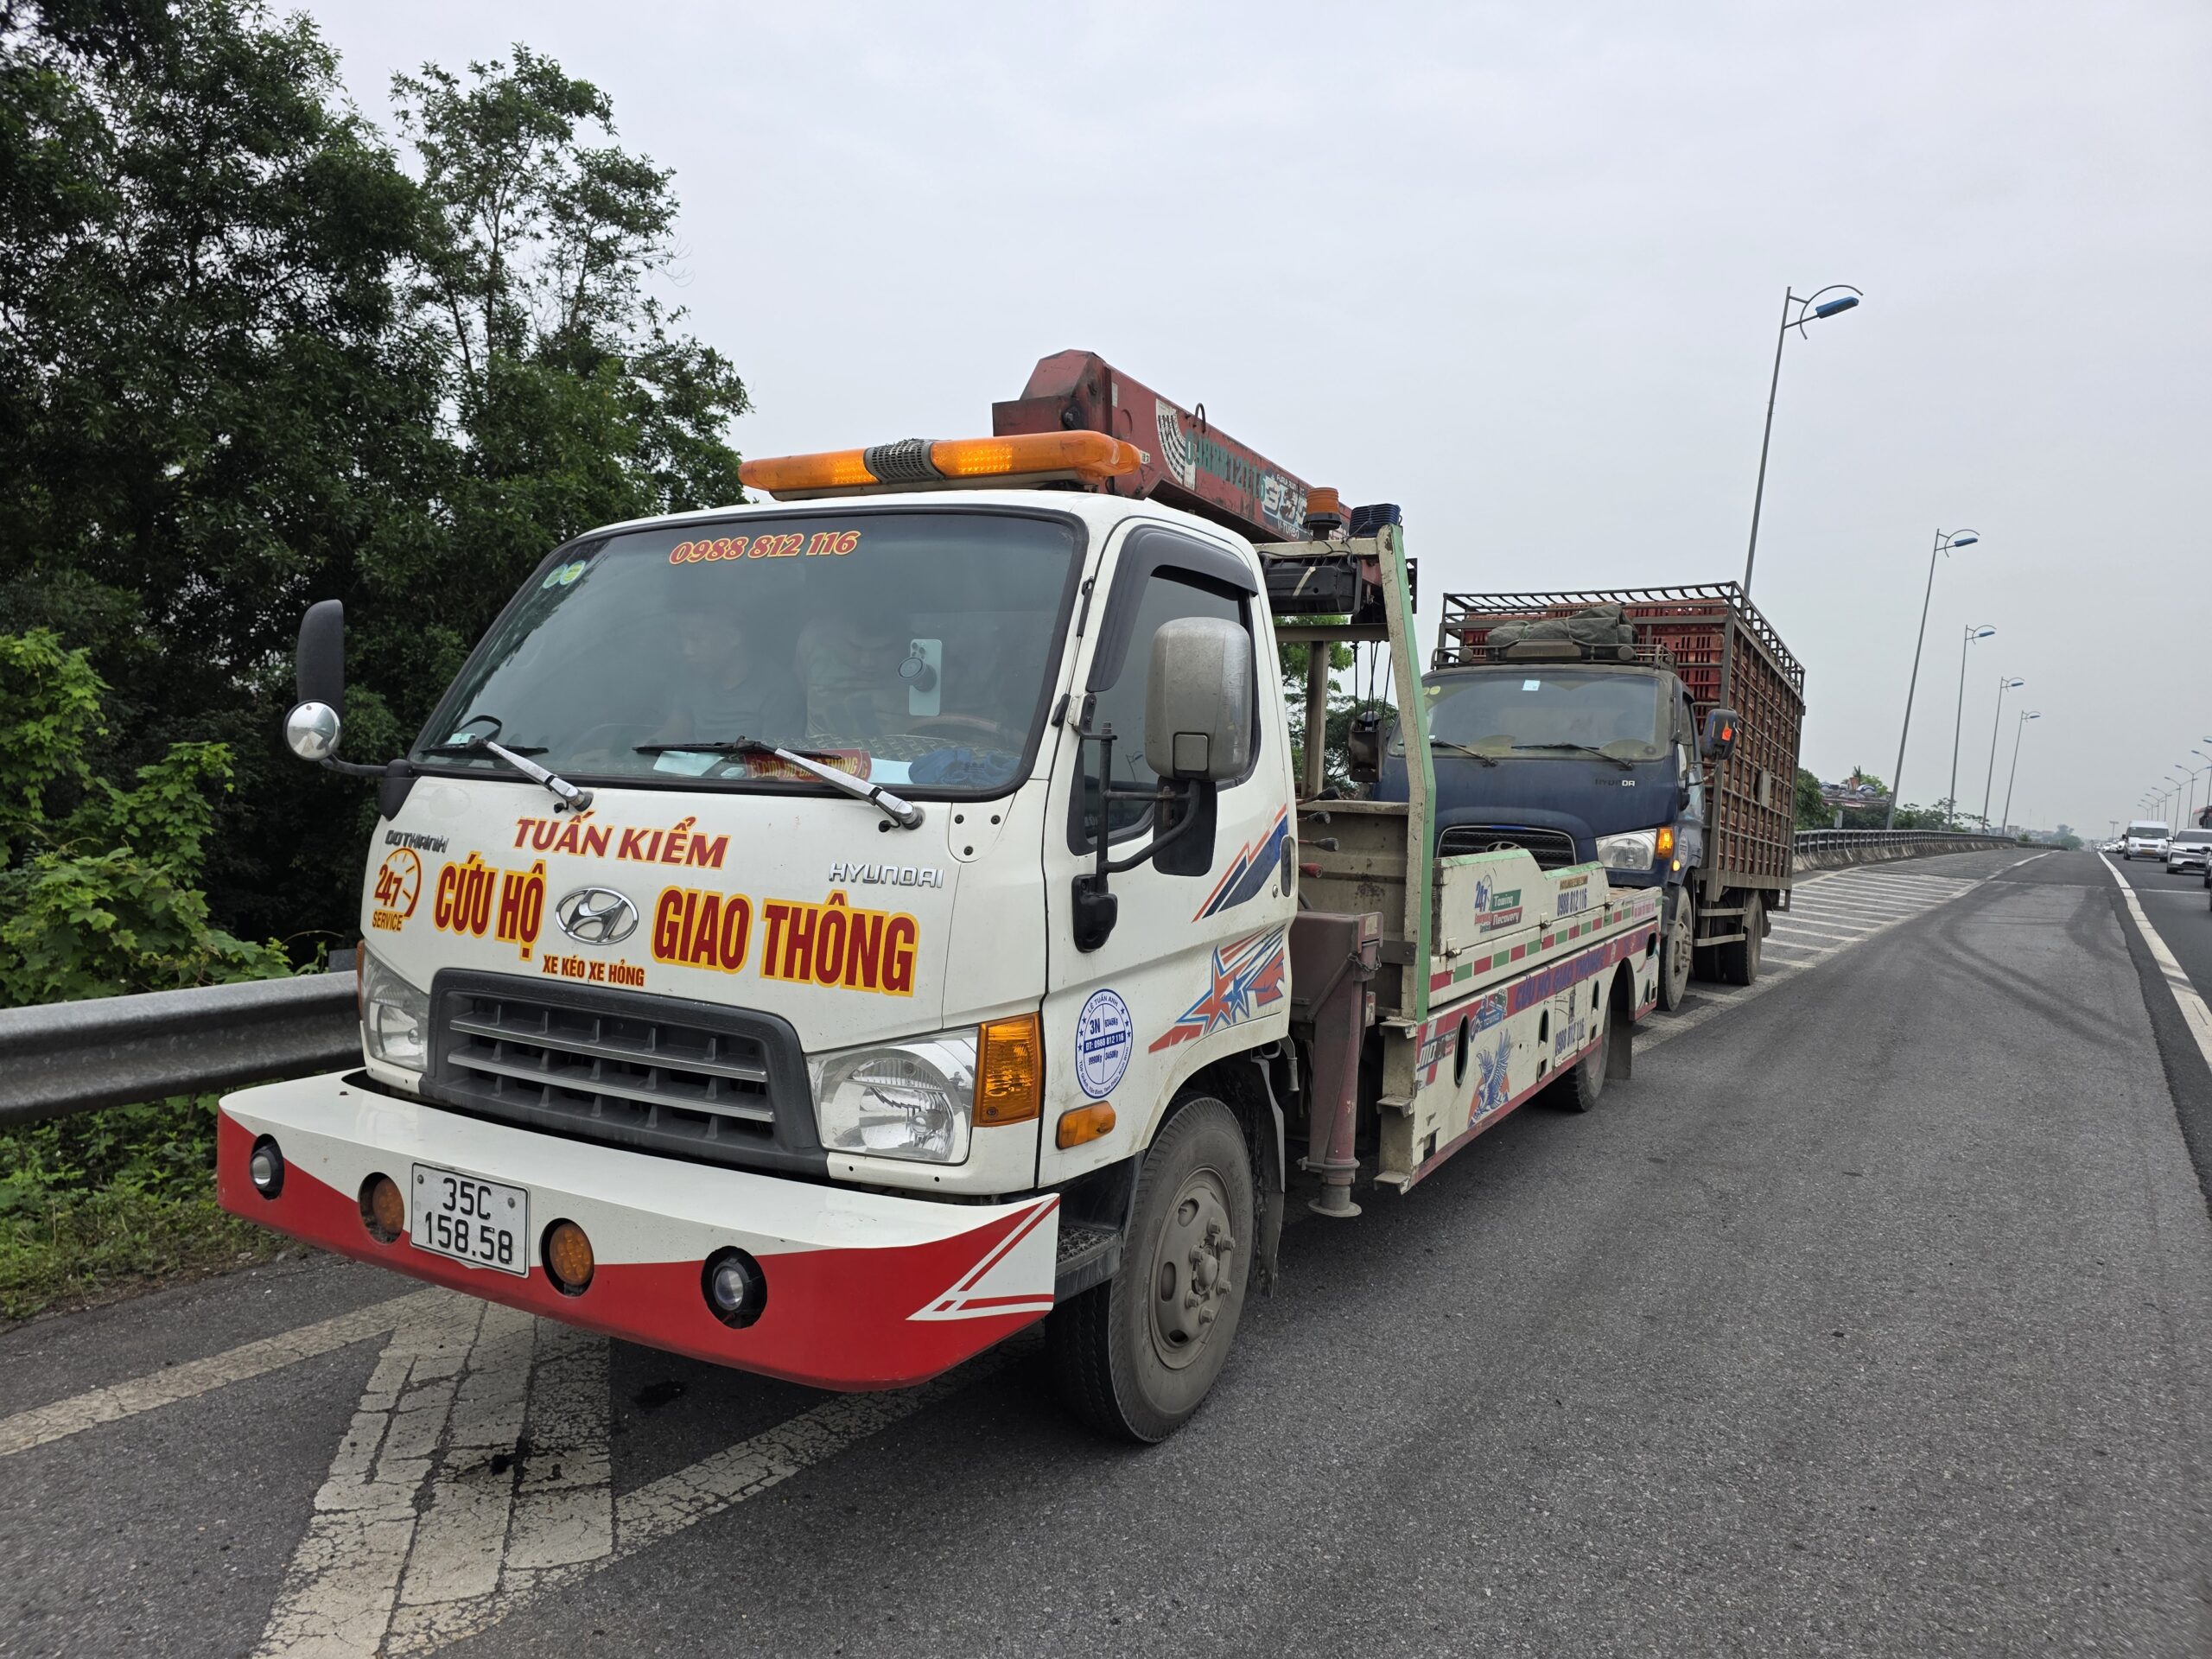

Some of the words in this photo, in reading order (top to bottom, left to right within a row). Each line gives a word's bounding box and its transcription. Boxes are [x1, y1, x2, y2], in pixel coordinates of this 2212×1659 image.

[669, 537, 749, 565] 0988
[747, 533, 804, 559] 812
[805, 531, 861, 556] 116
[513, 809, 615, 859] TUẤN
[615, 815, 732, 870] KIỂM
[829, 862, 944, 888] HYUNDAI
[1493, 893, 1514, 907] Towing
[372, 911, 404, 931] SERVICE
[434, 852, 497, 937] CỨU
[496, 861, 545, 960] HỘ
[652, 887, 753, 973] GIAO
[760, 890, 919, 996] THÔNG
[1493, 912, 1520, 926] Recovery
[543, 955, 559, 974] XE
[562, 955, 585, 978] KÉO
[588, 961, 605, 982] XE
[608, 959, 645, 986] HỎNG
[1087, 1002, 1095, 1014] LÊ
[1094, 994, 1108, 1005] TUẤN
[1108, 995, 1119, 1007] ANH
[1090, 1018, 1101, 1035] 3N
[1094, 1038, 1106, 1049] 0988
[1106, 1034, 1116, 1046] 812
[442, 1177, 493, 1220] 35C
[424, 1211, 513, 1265] 158.58
